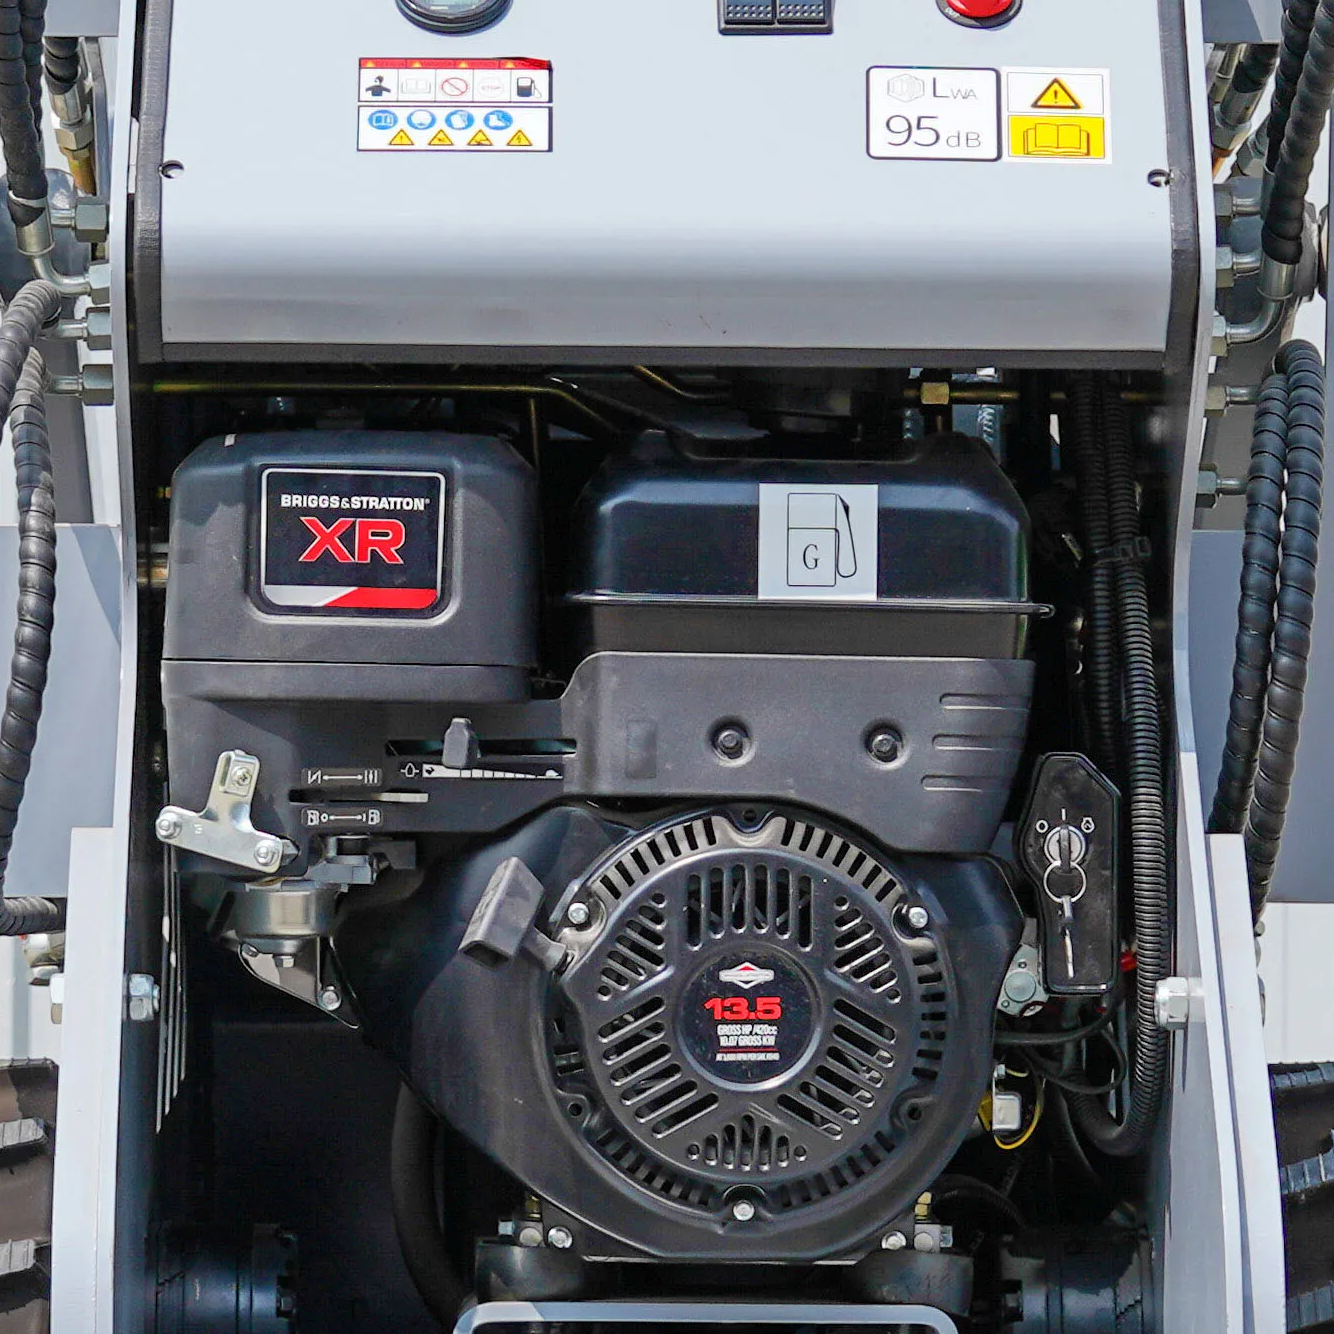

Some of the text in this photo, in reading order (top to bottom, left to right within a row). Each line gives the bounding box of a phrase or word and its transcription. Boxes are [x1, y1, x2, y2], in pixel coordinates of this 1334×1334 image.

[885, 114, 981, 148] 95 dB
[298, 516, 405, 564] XR
[803, 543, 820, 570] G
[704, 996, 783, 1021] 13.5
[717, 1024, 741, 1035] GROSS
[738, 1035, 762, 1046] GROSS
